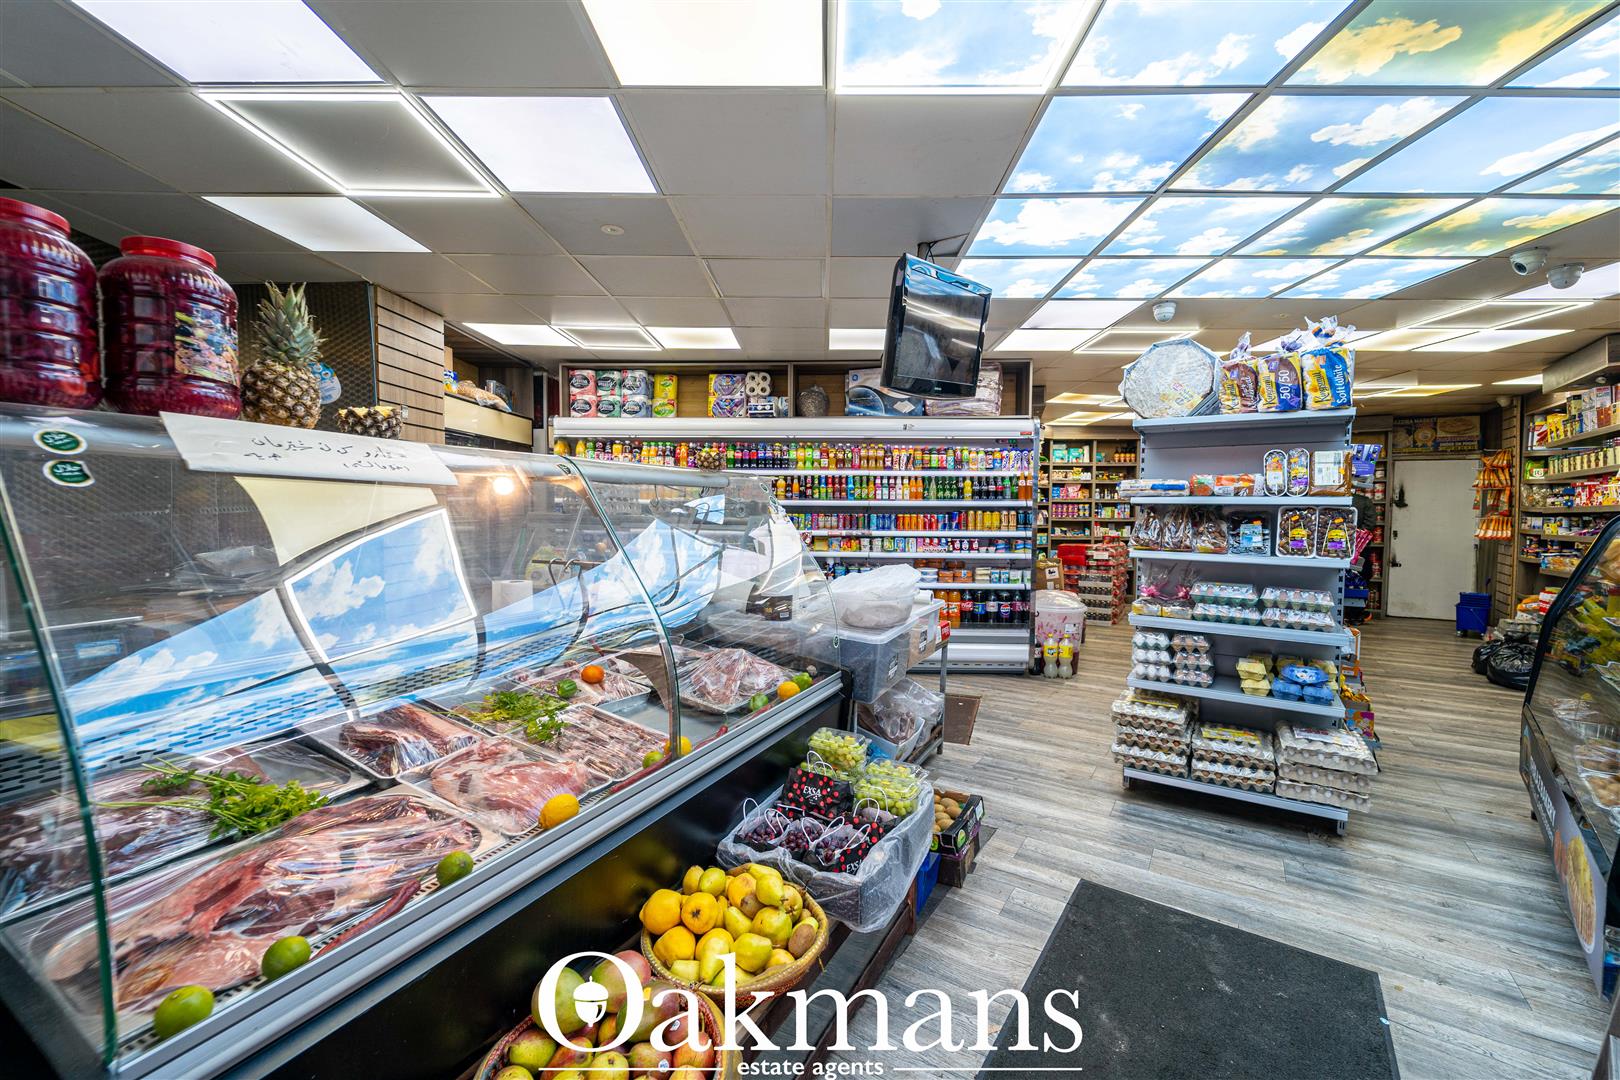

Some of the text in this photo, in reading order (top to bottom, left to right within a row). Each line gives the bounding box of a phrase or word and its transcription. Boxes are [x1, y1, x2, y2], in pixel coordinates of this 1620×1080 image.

[1279, 369, 1292, 399] 50/50
[1333, 364, 1348, 404] Soft White
